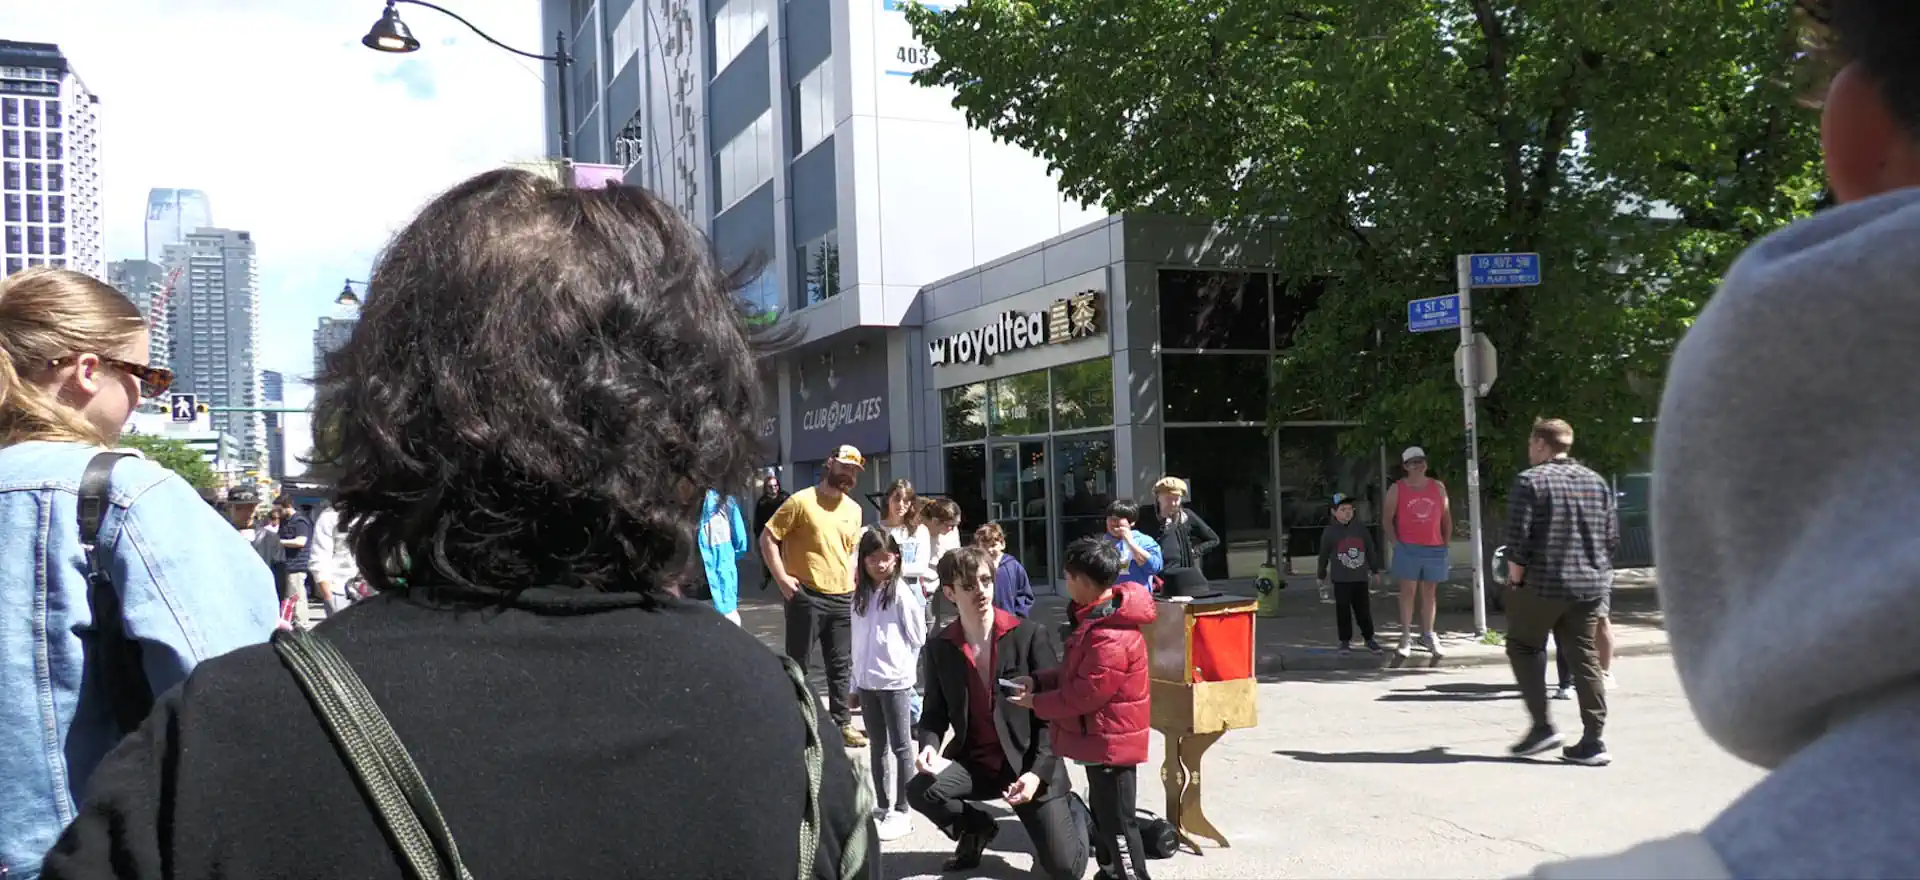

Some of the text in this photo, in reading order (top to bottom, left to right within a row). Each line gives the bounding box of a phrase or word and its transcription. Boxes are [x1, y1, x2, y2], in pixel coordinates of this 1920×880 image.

[897, 46, 935, 65] 403-
[1477, 257, 1490, 269] 19
[1493, 257, 1513, 269] AVE
[950, 291, 1096, 365] royaltea 皇茶
[803, 408, 827, 431] CLUB
[838, 396, 882, 425] PILATES
